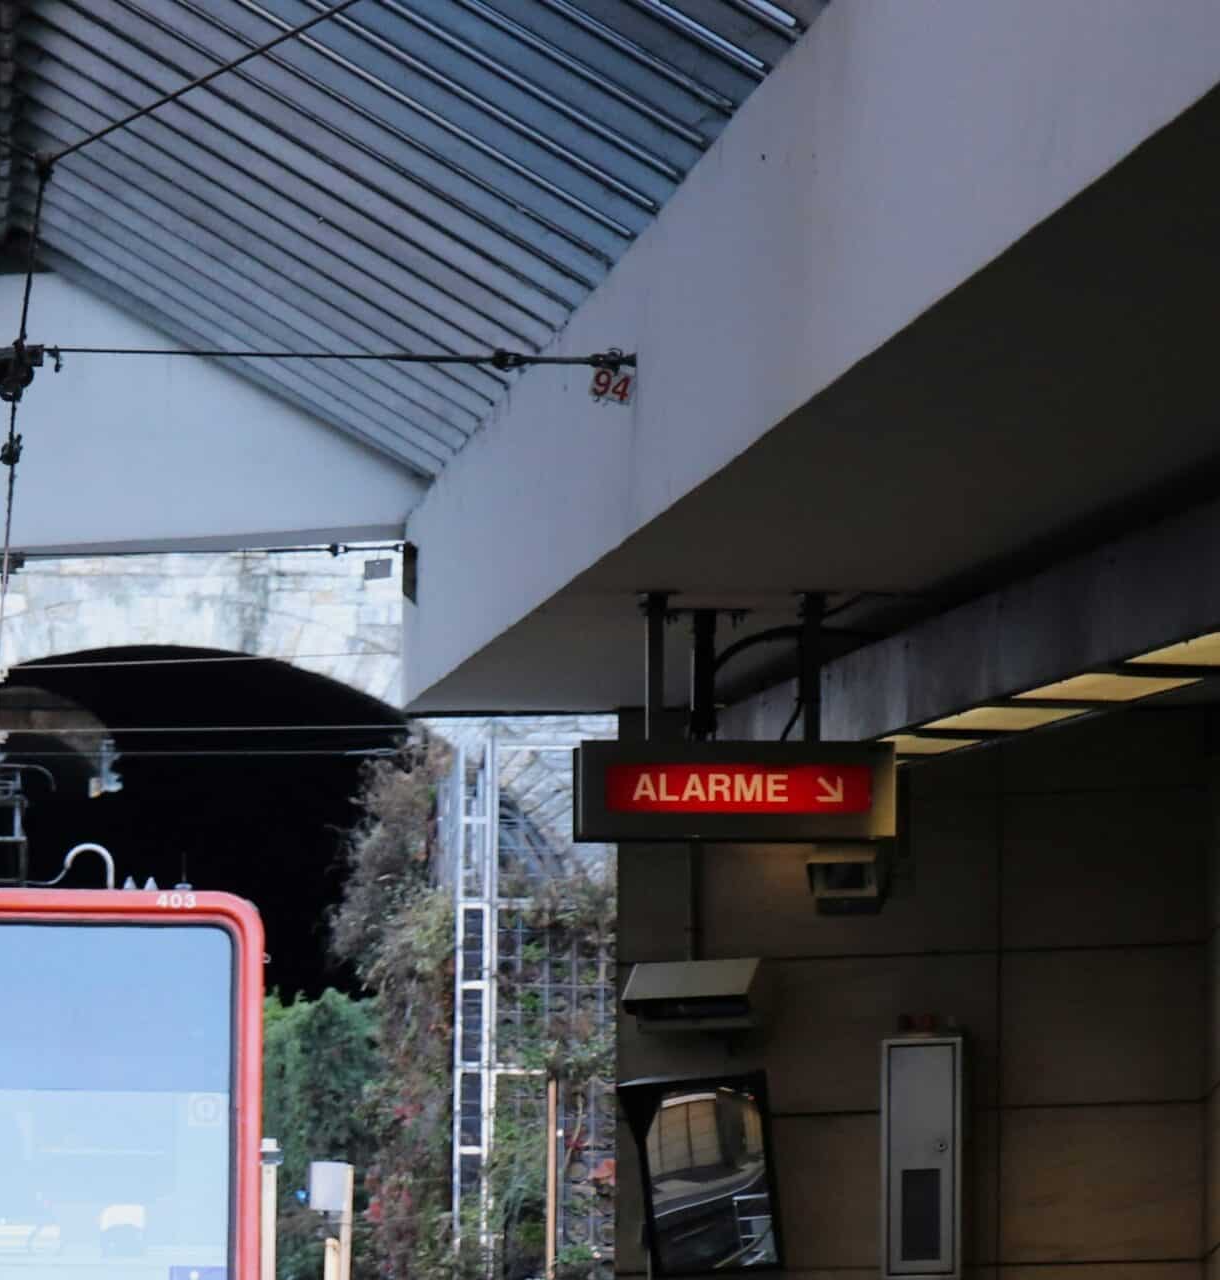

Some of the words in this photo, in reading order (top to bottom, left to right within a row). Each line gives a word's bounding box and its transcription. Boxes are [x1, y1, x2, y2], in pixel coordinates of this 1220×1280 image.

[592, 370, 631, 401] 94
[632, 772, 789, 802] ALARME
[156, 892, 197, 909] 403
